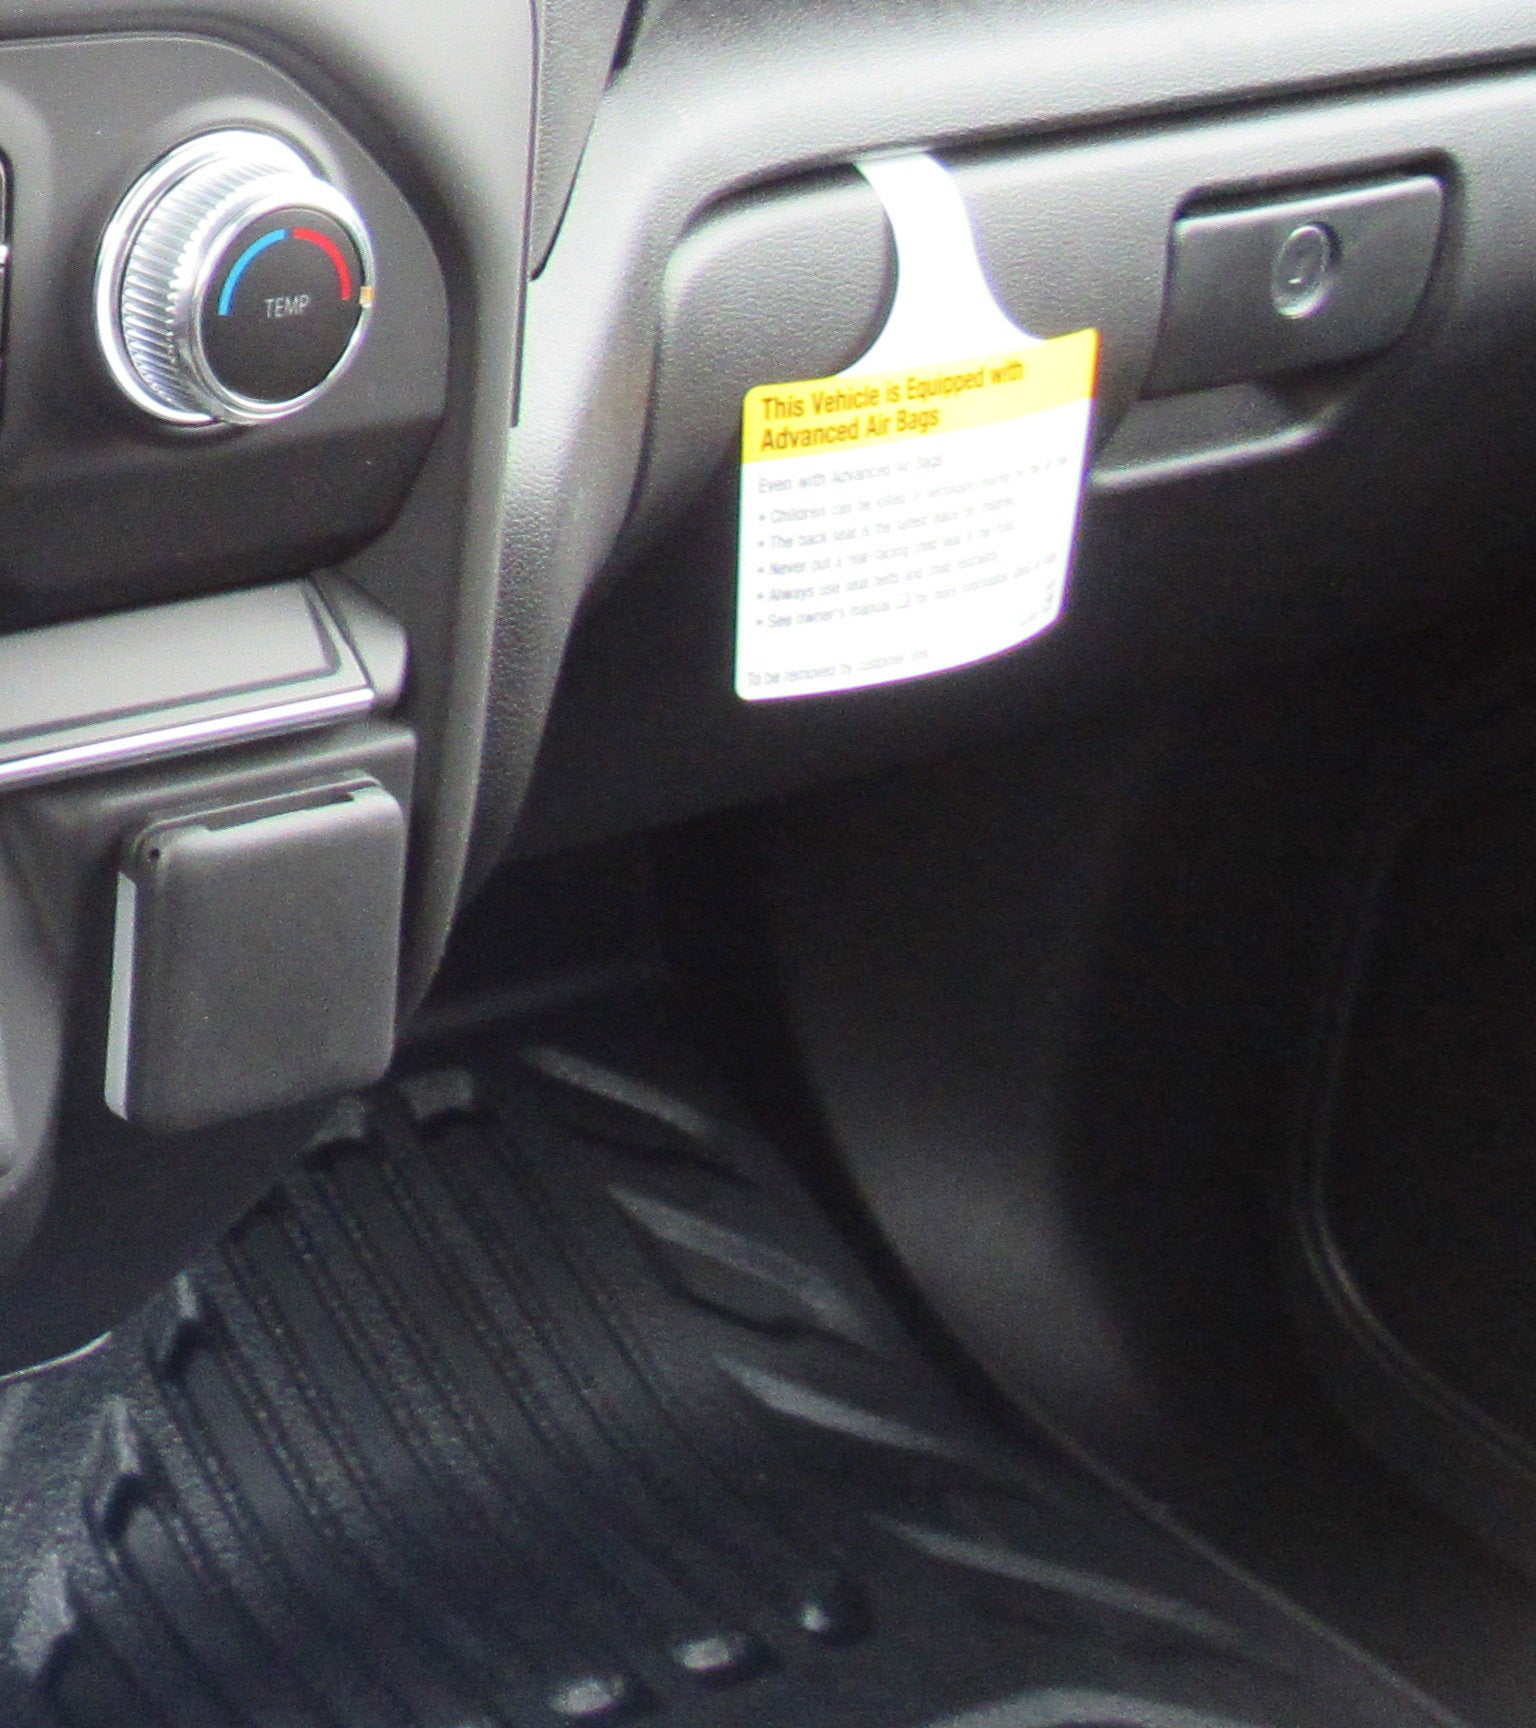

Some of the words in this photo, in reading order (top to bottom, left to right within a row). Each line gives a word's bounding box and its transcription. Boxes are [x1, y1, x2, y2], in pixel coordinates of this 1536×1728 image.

[265, 295, 310, 318] TEMP
[762, 396, 804, 421] This
[812, 387, 879, 415] Vehicle
[886, 387, 901, 403] is
[906, 368, 984, 401] Equipped
[990, 360, 1024, 383] with
[760, 418, 859, 451] Advanced
[866, 414, 891, 435] Air
[896, 407, 940, 433] Bags
